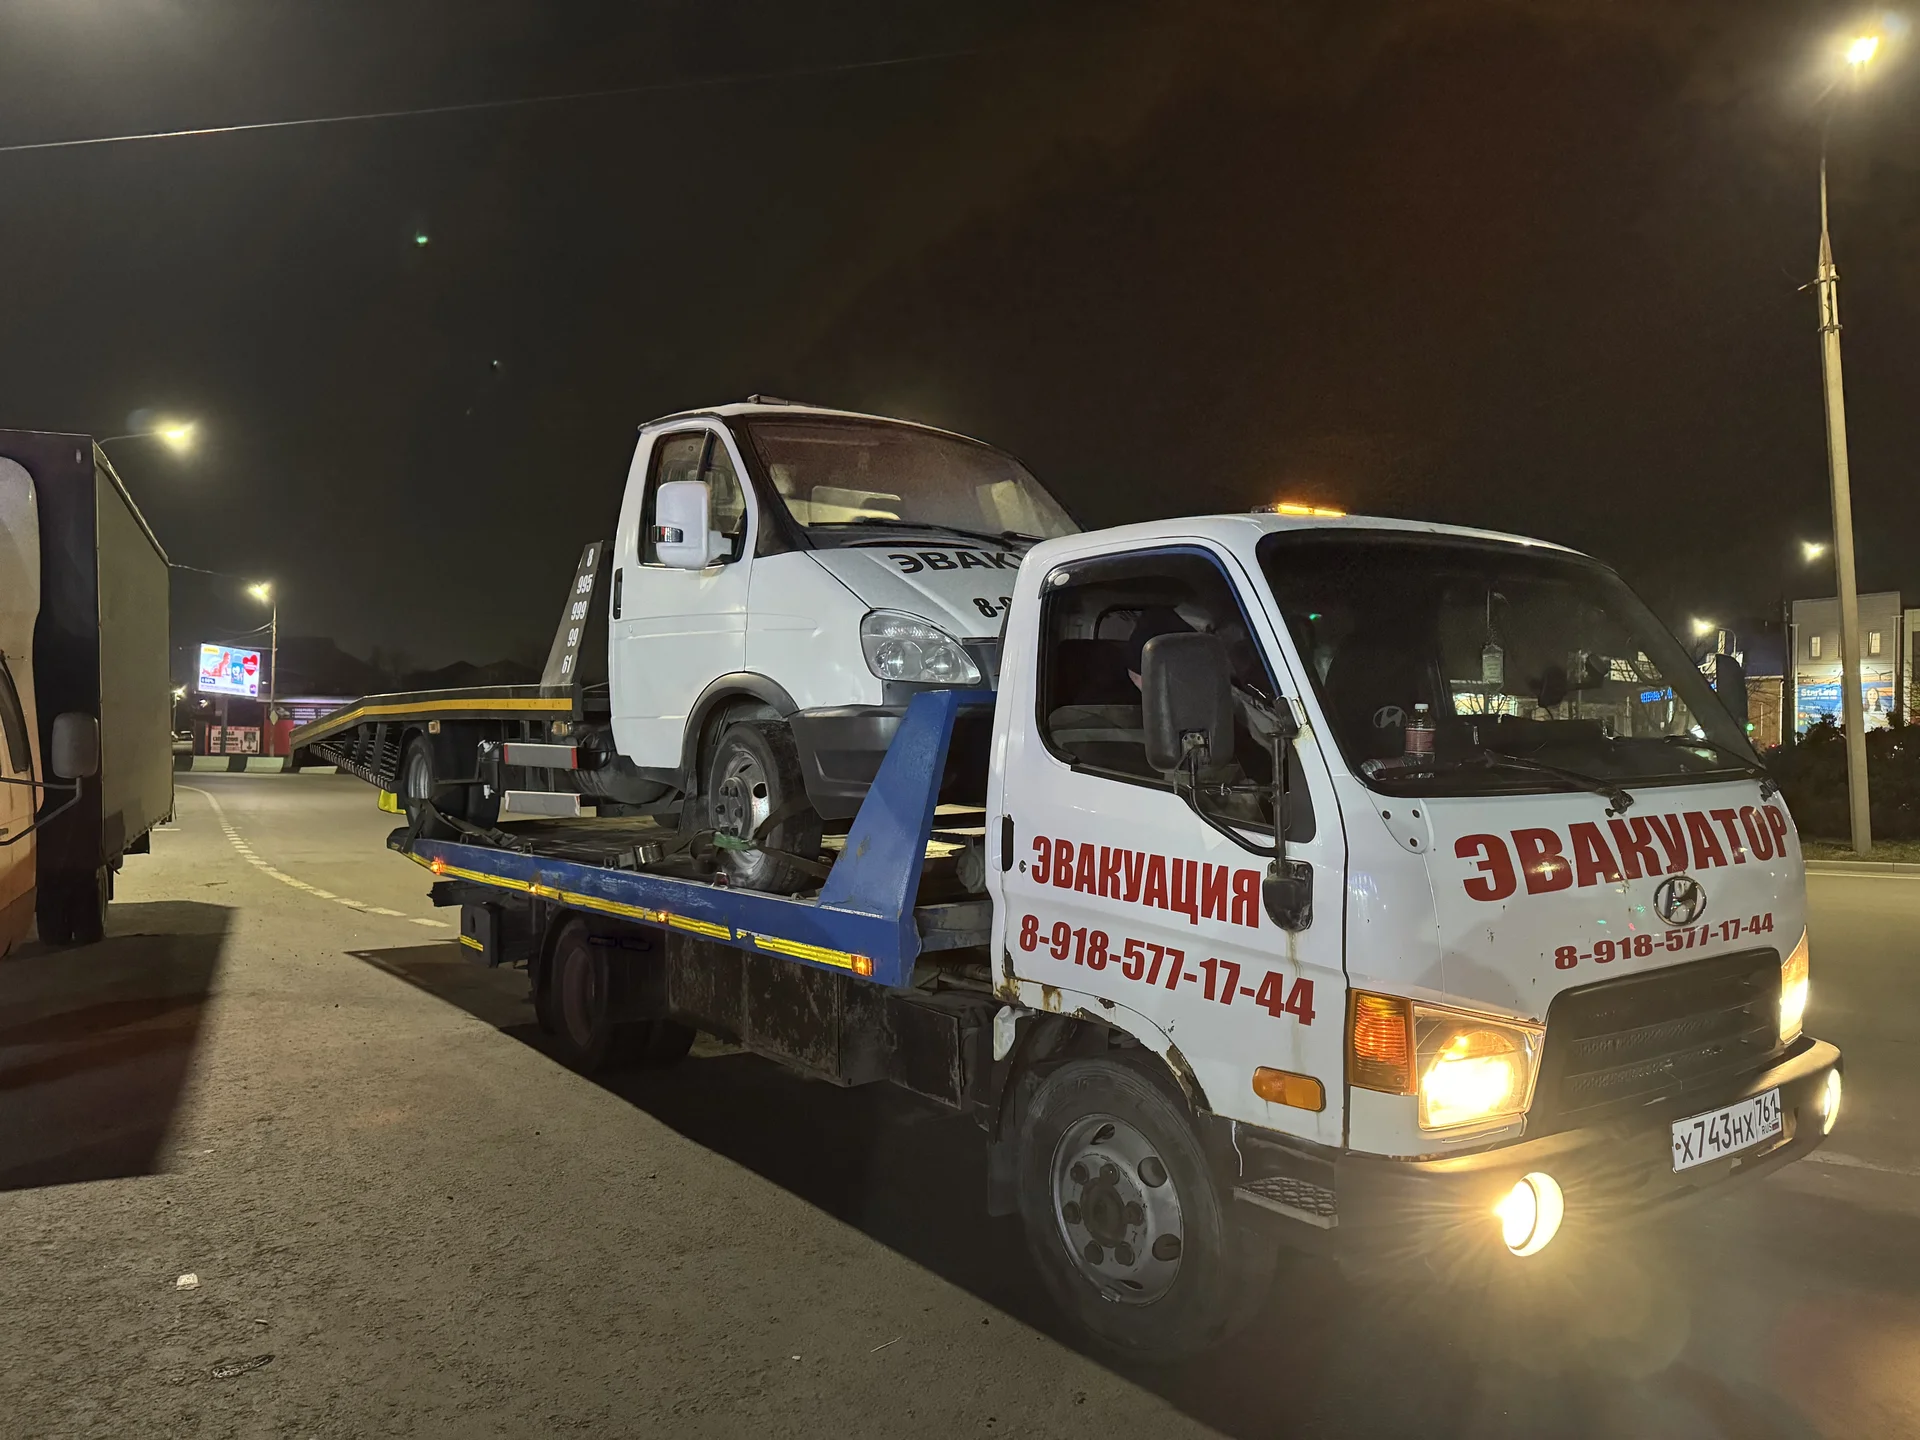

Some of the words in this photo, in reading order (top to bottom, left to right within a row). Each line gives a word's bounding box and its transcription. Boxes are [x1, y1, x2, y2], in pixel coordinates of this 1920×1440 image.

[586, 547, 595, 567] 8
[576, 573, 594, 595] 995
[570, 600, 588, 621] 999
[566, 627, 580, 647] 99
[561, 654, 573, 674] 61
[1454, 805, 1788, 902] ЭВАКУАТОР
[1031, 835, 1261, 929] ЭВАКУАЦИЯ
[1554, 912, 1774, 970] 8-918-577-17-44
[1019, 914, 1316, 1026] 8-918-577-17-44
[1755, 1092, 1778, 1126] 761
